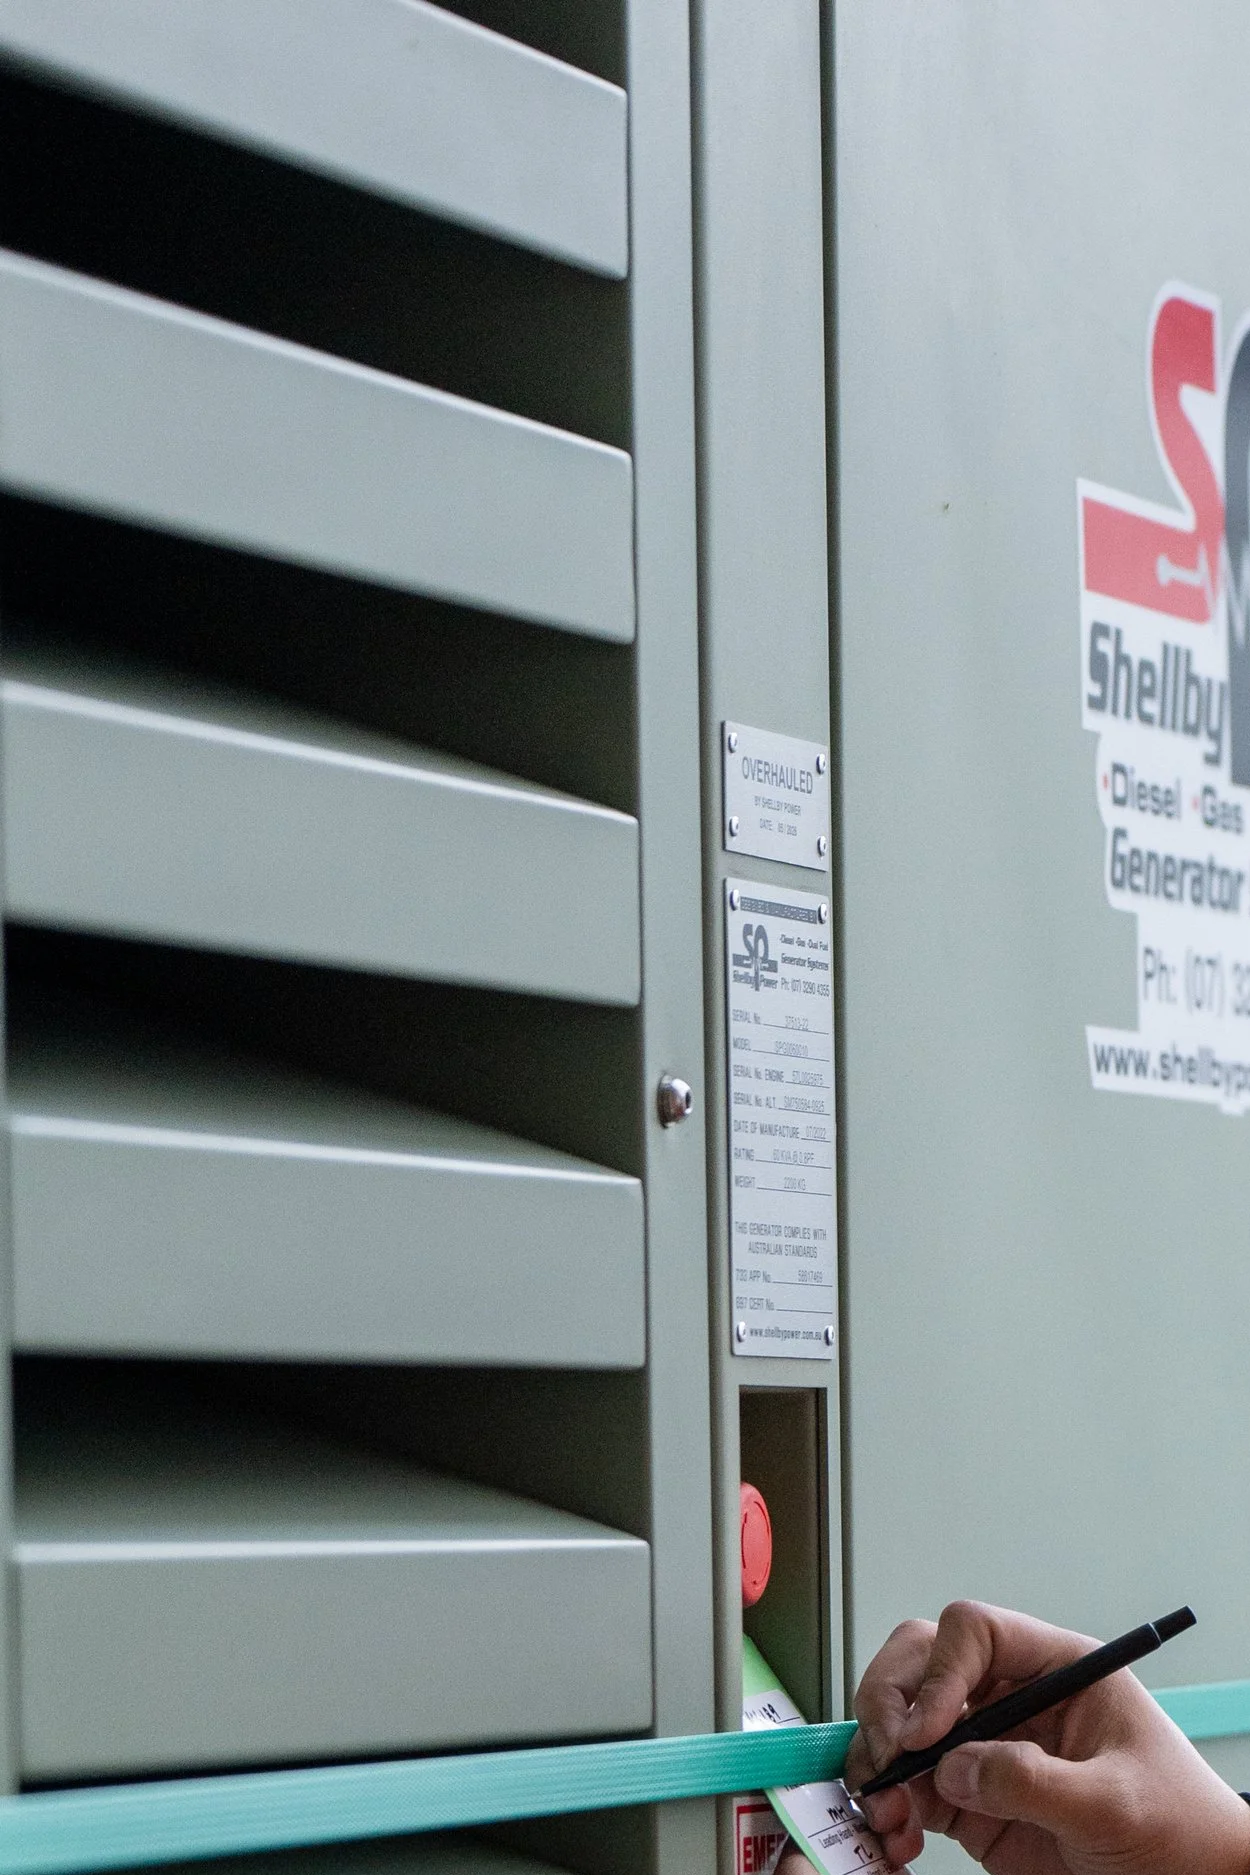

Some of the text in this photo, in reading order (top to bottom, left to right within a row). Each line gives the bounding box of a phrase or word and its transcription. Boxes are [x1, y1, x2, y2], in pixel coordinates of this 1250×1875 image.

[1087, 621, 1226, 768] Shellby
[742, 756, 813, 794] OVERHAULED
[1111, 762, 1182, 821] Diesel
[1201, 786, 1244, 835] Gas
[1110, 828, 1246, 914] Generator
[781, 952, 806, 967] Generator
[1143, 946, 1178, 1003] Ph:
[732, 1037, 752, 1051] MODEL
[734, 1119, 749, 1134] DATE
[759, 1124, 800, 1140] MANUFACTURE
[734, 1147, 755, 1162] RATING
[734, 1175, 755, 1189] WEIGHT
[750, 1222, 783, 1238] GENERATOR
[784, 1225, 812, 1240] COMPLIES
[813, 1228, 827, 1241] WITH
[748, 1241, 818, 1259] AUSTRALIAN STANDARDS
[750, 1325, 822, 1342] www.shellbypower.com.au
[818, 1832, 843, 1849] Leading
